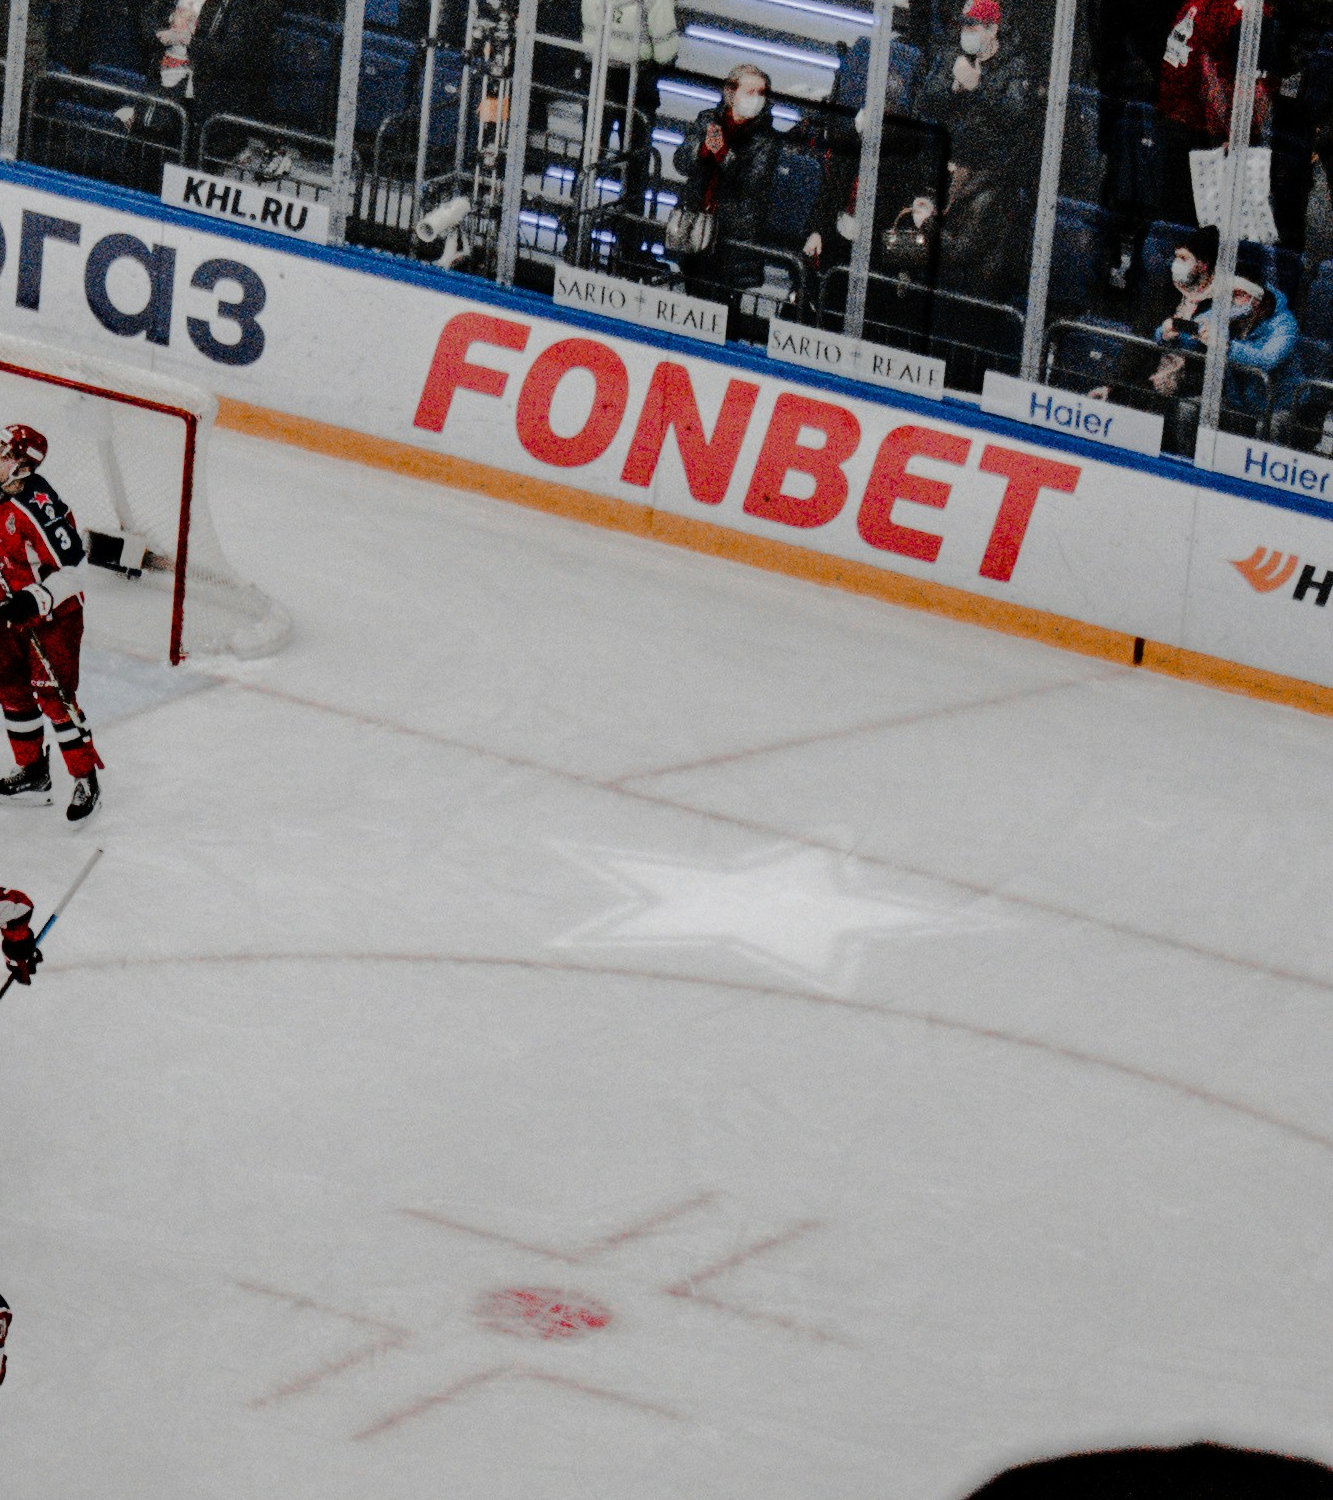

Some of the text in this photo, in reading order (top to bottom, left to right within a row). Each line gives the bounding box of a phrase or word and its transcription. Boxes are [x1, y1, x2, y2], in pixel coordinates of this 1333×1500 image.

[182, 174, 309, 234] KHL.RU
[556, 274, 723, 337] SARTO REALE
[770, 327, 842, 364] SARTO
[1029, 391, 1113, 438] Haier
[413, 312, 1082, 581] FONBET
[1243, 447, 1330, 494] Haier
[54, 527, 71, 552] 3
